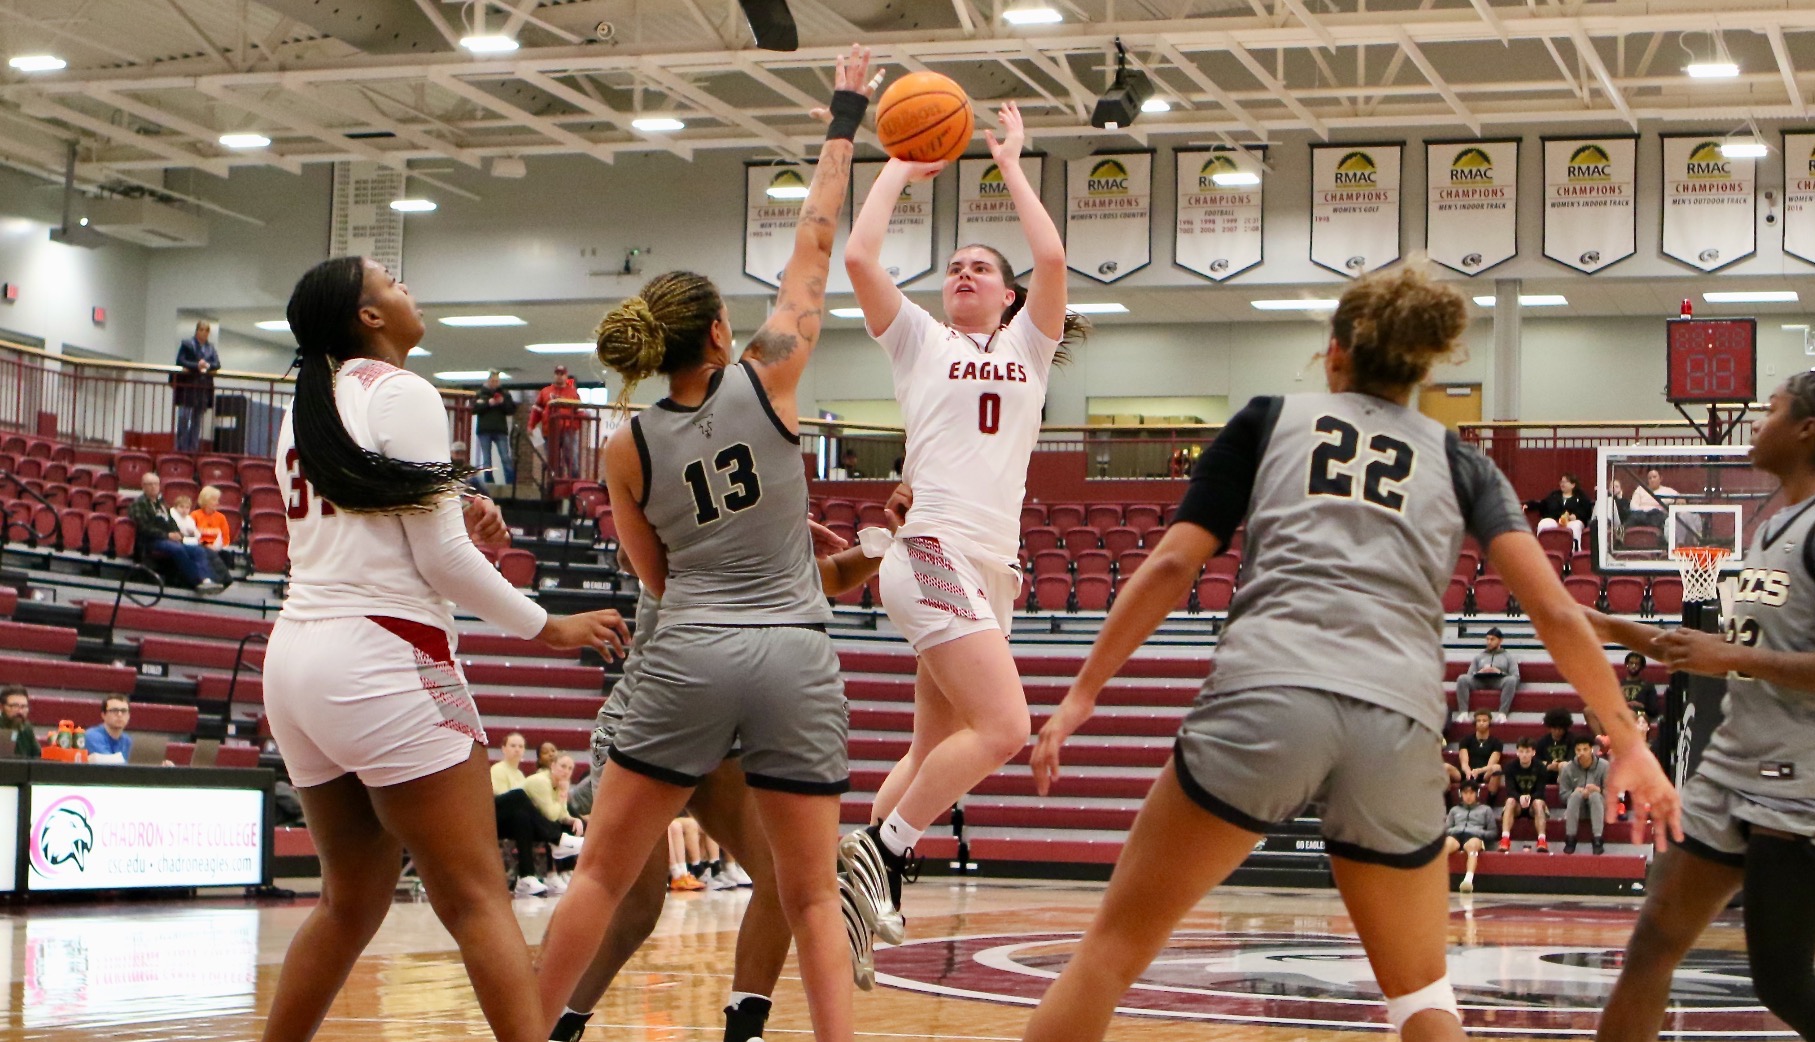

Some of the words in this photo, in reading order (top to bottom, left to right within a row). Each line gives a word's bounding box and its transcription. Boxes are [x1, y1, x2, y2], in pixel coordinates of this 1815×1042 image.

[1451, 168, 1493, 180] RMAC
[1568, 165, 1611, 177] RMAC
[1687, 162, 1731, 174] RMAC
[1335, 171, 1376, 184] RMAC
[980, 183, 1010, 193] RMA
[1088, 179, 1128, 190] RMAC
[1557, 185, 1622, 196] CHAMPIONS
[1676, 183, 1743, 193] CHAMPIONS
[1324, 191, 1388, 202] CHAMPIONS
[1440, 188, 1505, 199] CHAMPIONS
[969, 201, 1016, 211] CHAMPIO
[1078, 198, 1139, 209] CHAMPIONS
[1188, 195, 1251, 205] CHAMPIONS
[757, 208, 801, 217] CHAMPIO
[949, 362, 1026, 382] EAGLES
[979, 392, 1001, 434] 0
[1305, 415, 1418, 515] 22
[285, 448, 338, 520] 3
[682, 442, 762, 528] 13
[101, 822, 163, 847] CHADRON
[168, 823, 203, 847] STATE
[207, 823, 257, 847] COLLEGE
[108, 854, 145, 873] csc.edu
[157, 853, 252, 877] chadroneagles.com
